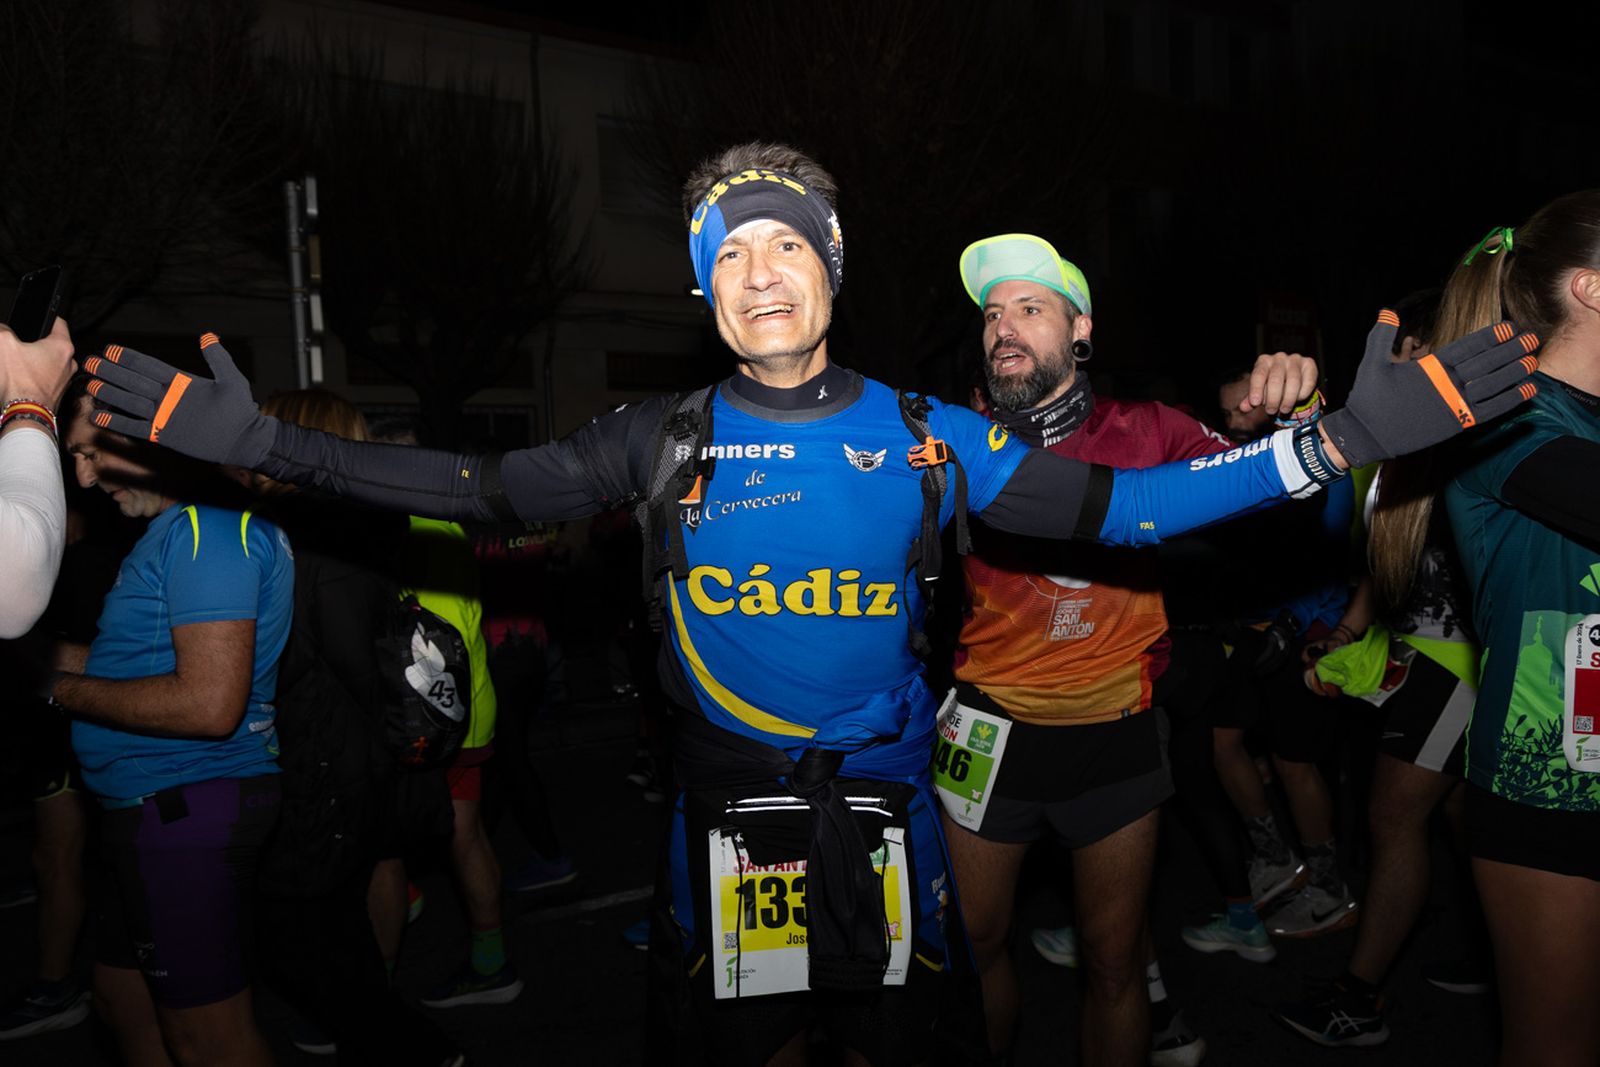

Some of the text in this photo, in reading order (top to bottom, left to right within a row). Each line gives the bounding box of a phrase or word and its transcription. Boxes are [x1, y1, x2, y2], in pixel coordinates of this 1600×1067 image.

[744, 469, 767, 487] de
[679, 490, 801, 528] La Cervecera
[686, 563, 899, 618] Cádiz
[1053, 612, 1080, 625] SAN
[427, 680, 456, 708] 43
